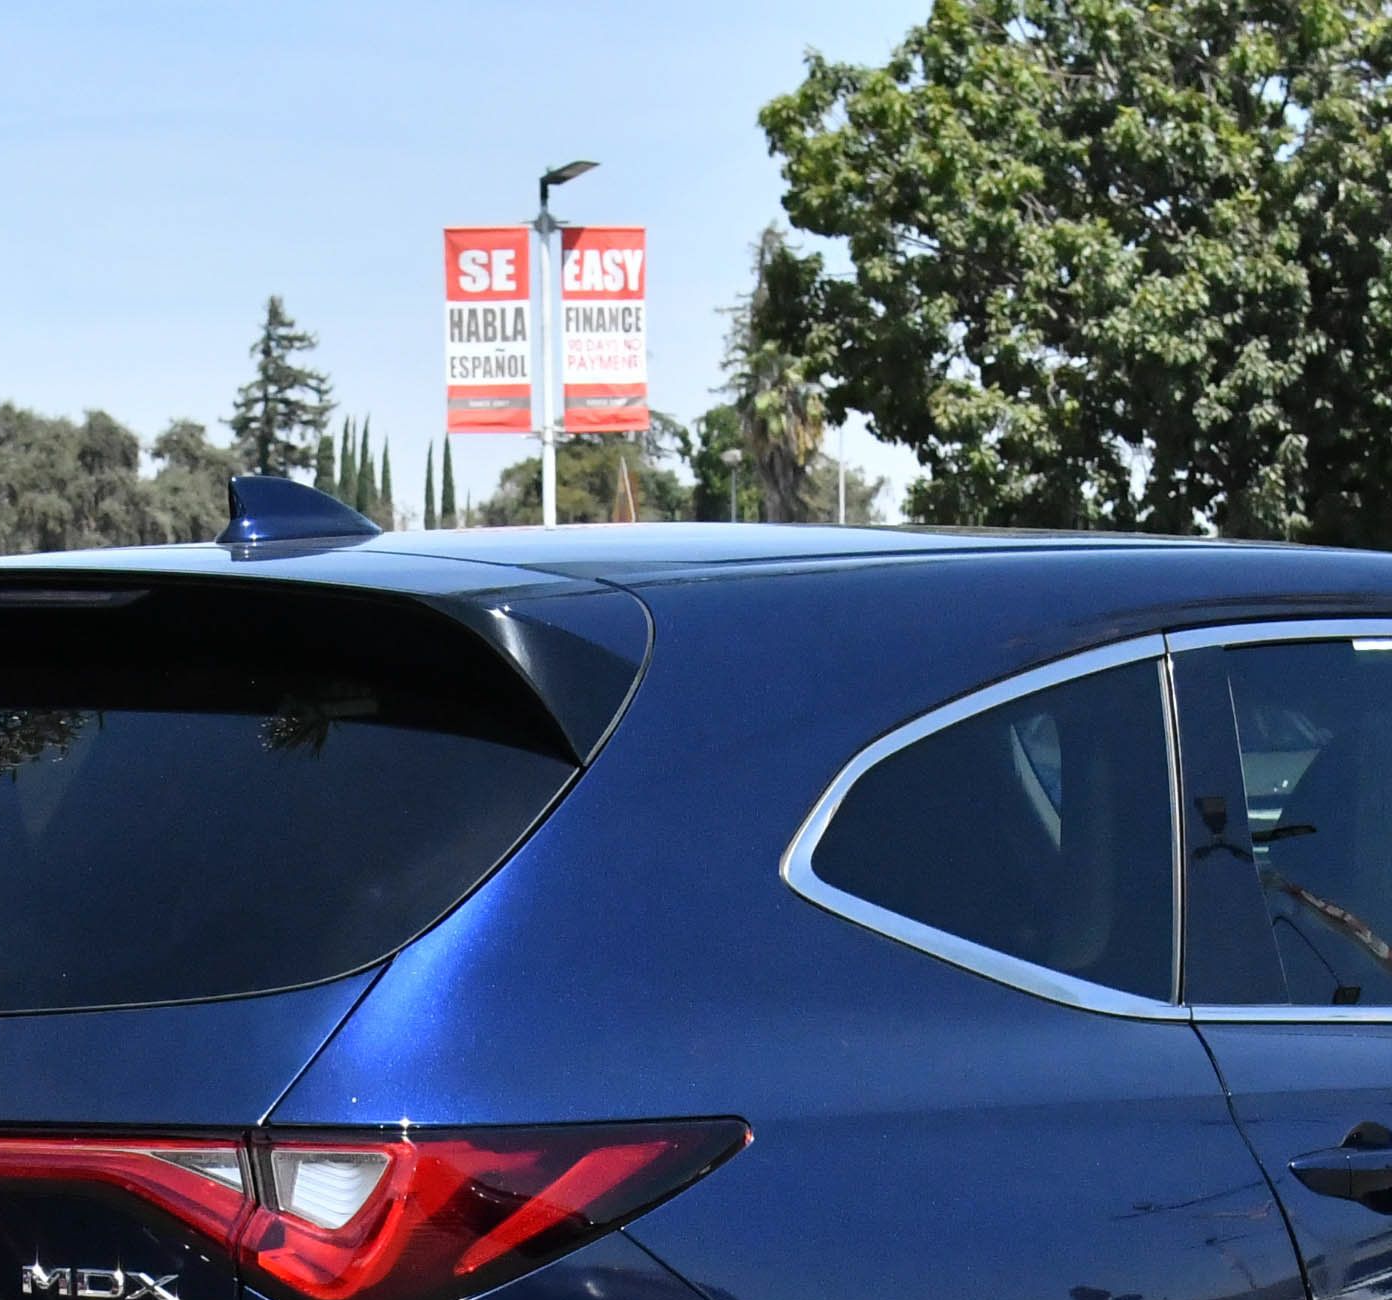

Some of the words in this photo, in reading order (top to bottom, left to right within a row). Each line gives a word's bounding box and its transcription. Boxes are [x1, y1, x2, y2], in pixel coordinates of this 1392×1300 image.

[458, 249, 517, 292] SE
[563, 249, 643, 292] EASY
[449, 307, 527, 343] HABLA
[565, 307, 642, 333] FINANCE
[450, 347, 527, 378] ESPAÑOL
